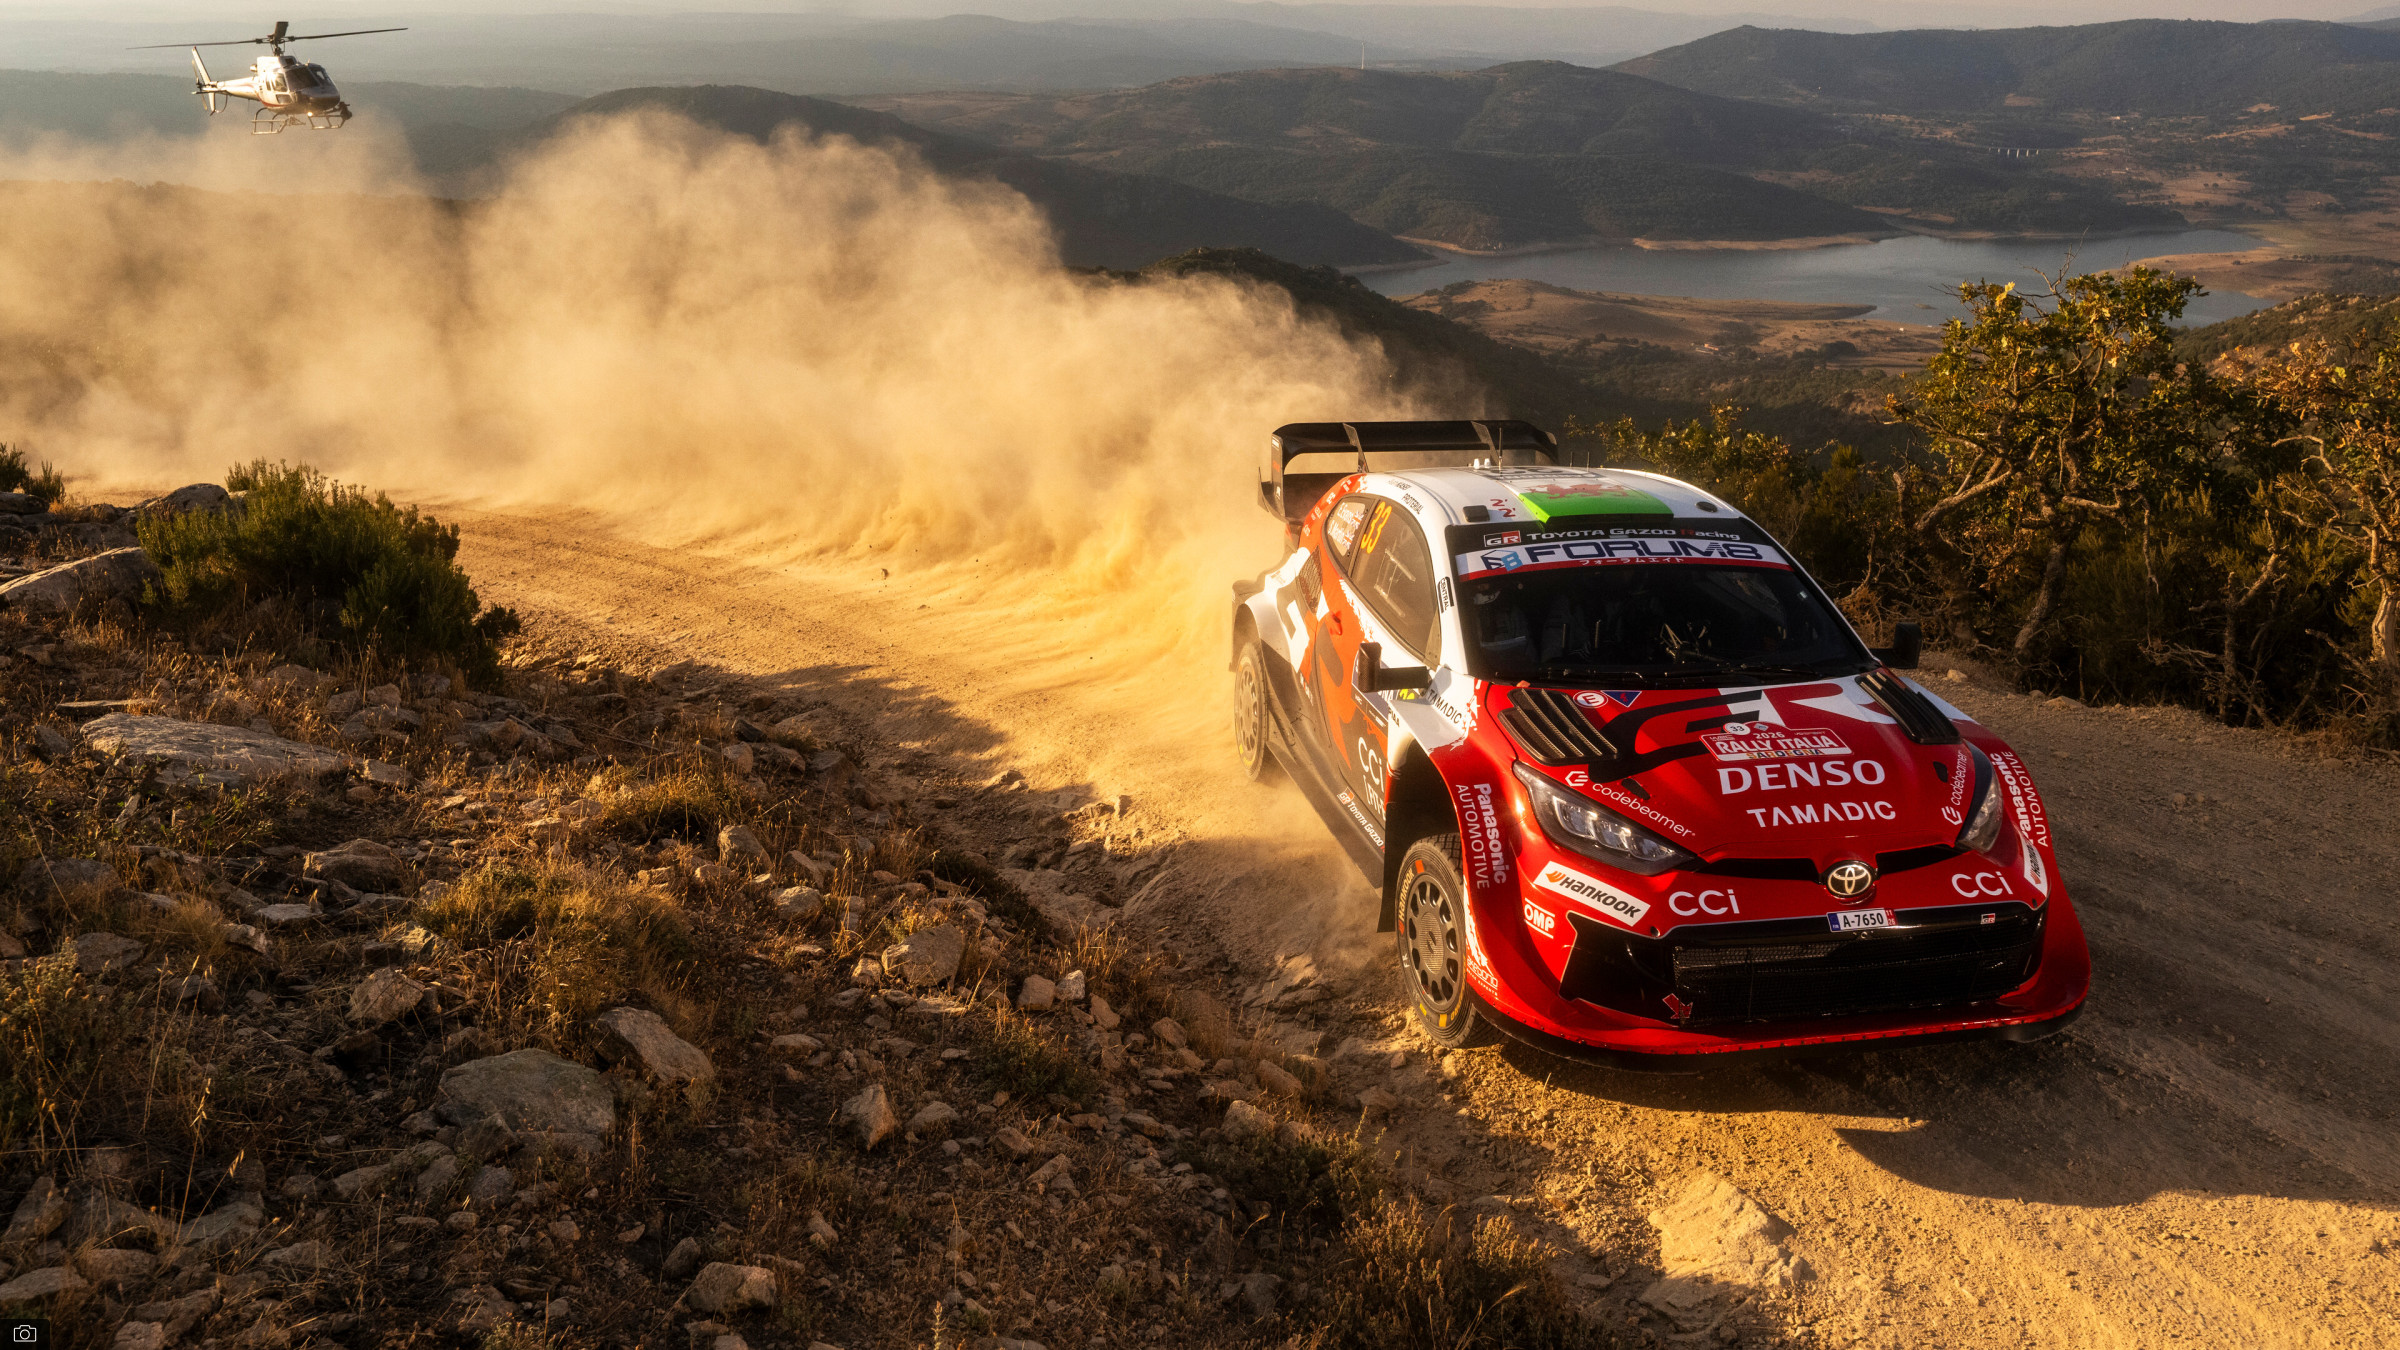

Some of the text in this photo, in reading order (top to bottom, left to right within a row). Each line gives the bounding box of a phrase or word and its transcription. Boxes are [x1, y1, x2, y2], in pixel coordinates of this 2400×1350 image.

[1360, 501, 1392, 554] 33
[1486, 534, 1520, 546] GR
[1527, 528, 1741, 541] TOYOTA GAZOO Racing
[1525, 540, 1763, 562] FORUM8
[1440, 578, 1450, 611] CENTRAL
[1426, 690, 1463, 724] TAMADIC
[1715, 735, 1839, 753] RALLY ITALIA
[1746, 749, 1823, 759] SARDEGNA
[1717, 759, 1886, 795] DENSO
[1951, 750, 1967, 806] codebeamer
[1592, 783, 1692, 837] codebeamer
[2001, 751, 2049, 847] AUTOMOTIVE
[1347, 801, 1367, 826] TOYOTA
[1364, 822, 1384, 847] GAZOO
[1746, 800, 1896, 828] TAMADIC
[1455, 784, 1490, 890] AUTOMOTIVE
[1473, 783, 1509, 884] Panasonic
[1951, 871, 2014, 898] CCi
[1524, 902, 1555, 931] OMP
[1668, 888, 1740, 916] CCi
[1843, 912, 1884, 928] A-7650
[1888, 918, 1896, 926] 26
